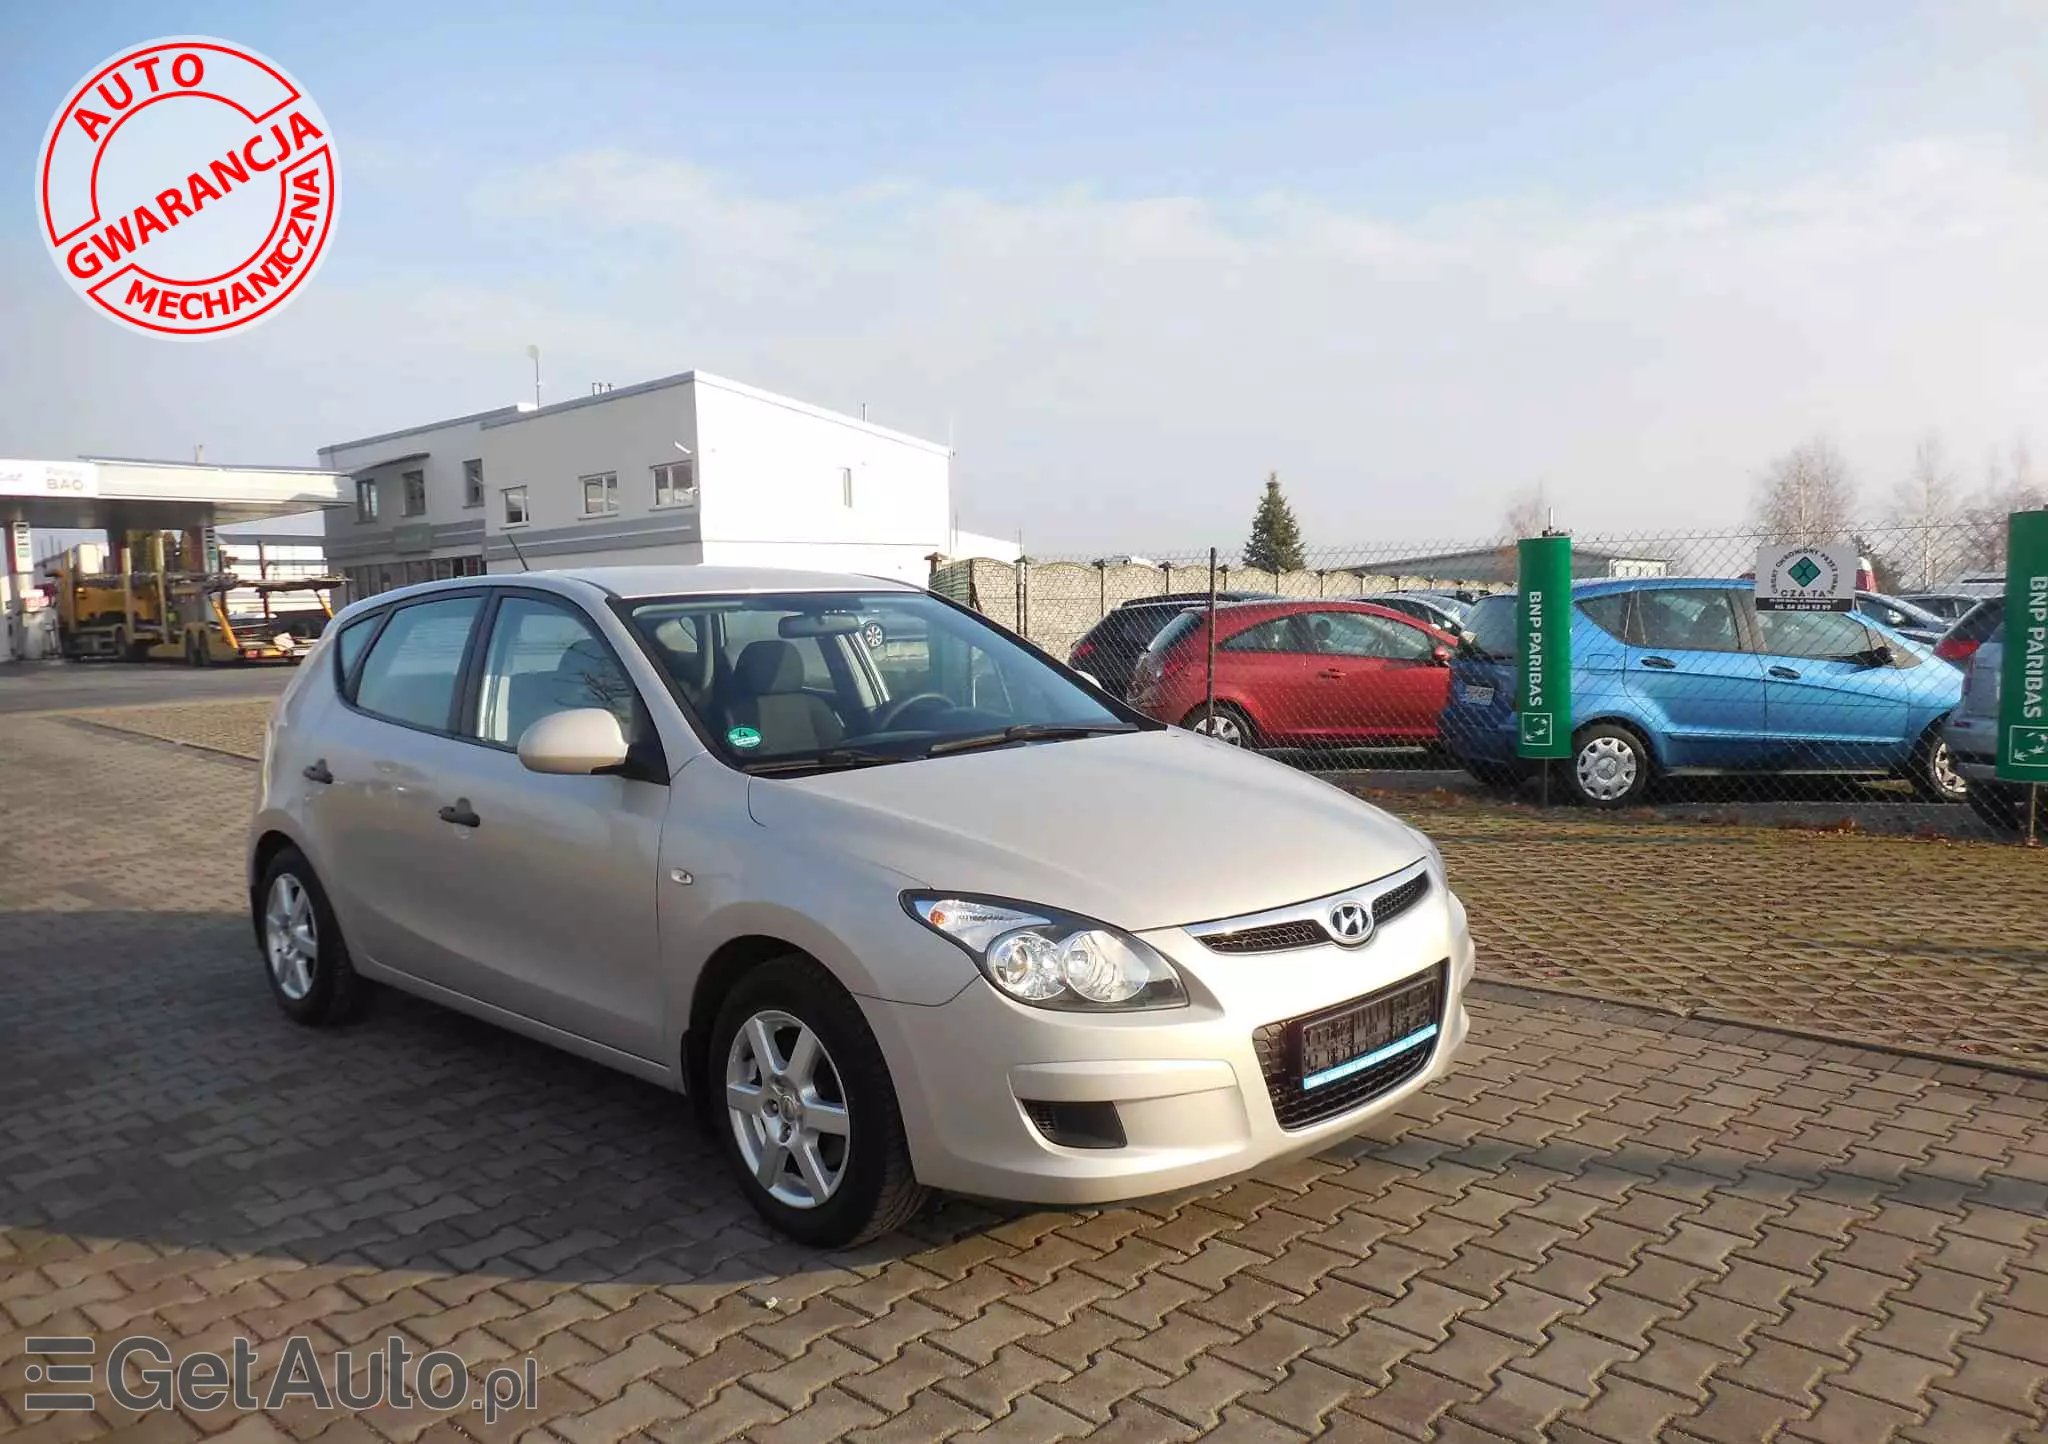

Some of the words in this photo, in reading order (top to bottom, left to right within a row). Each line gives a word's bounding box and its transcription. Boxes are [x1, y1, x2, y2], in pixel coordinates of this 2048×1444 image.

[1528, 591, 1542, 629] BNP
[2028, 576, 2048, 622] BNP
[1528, 632, 1542, 707] PARIBAS
[2023, 627, 2046, 719] PARIBAS
